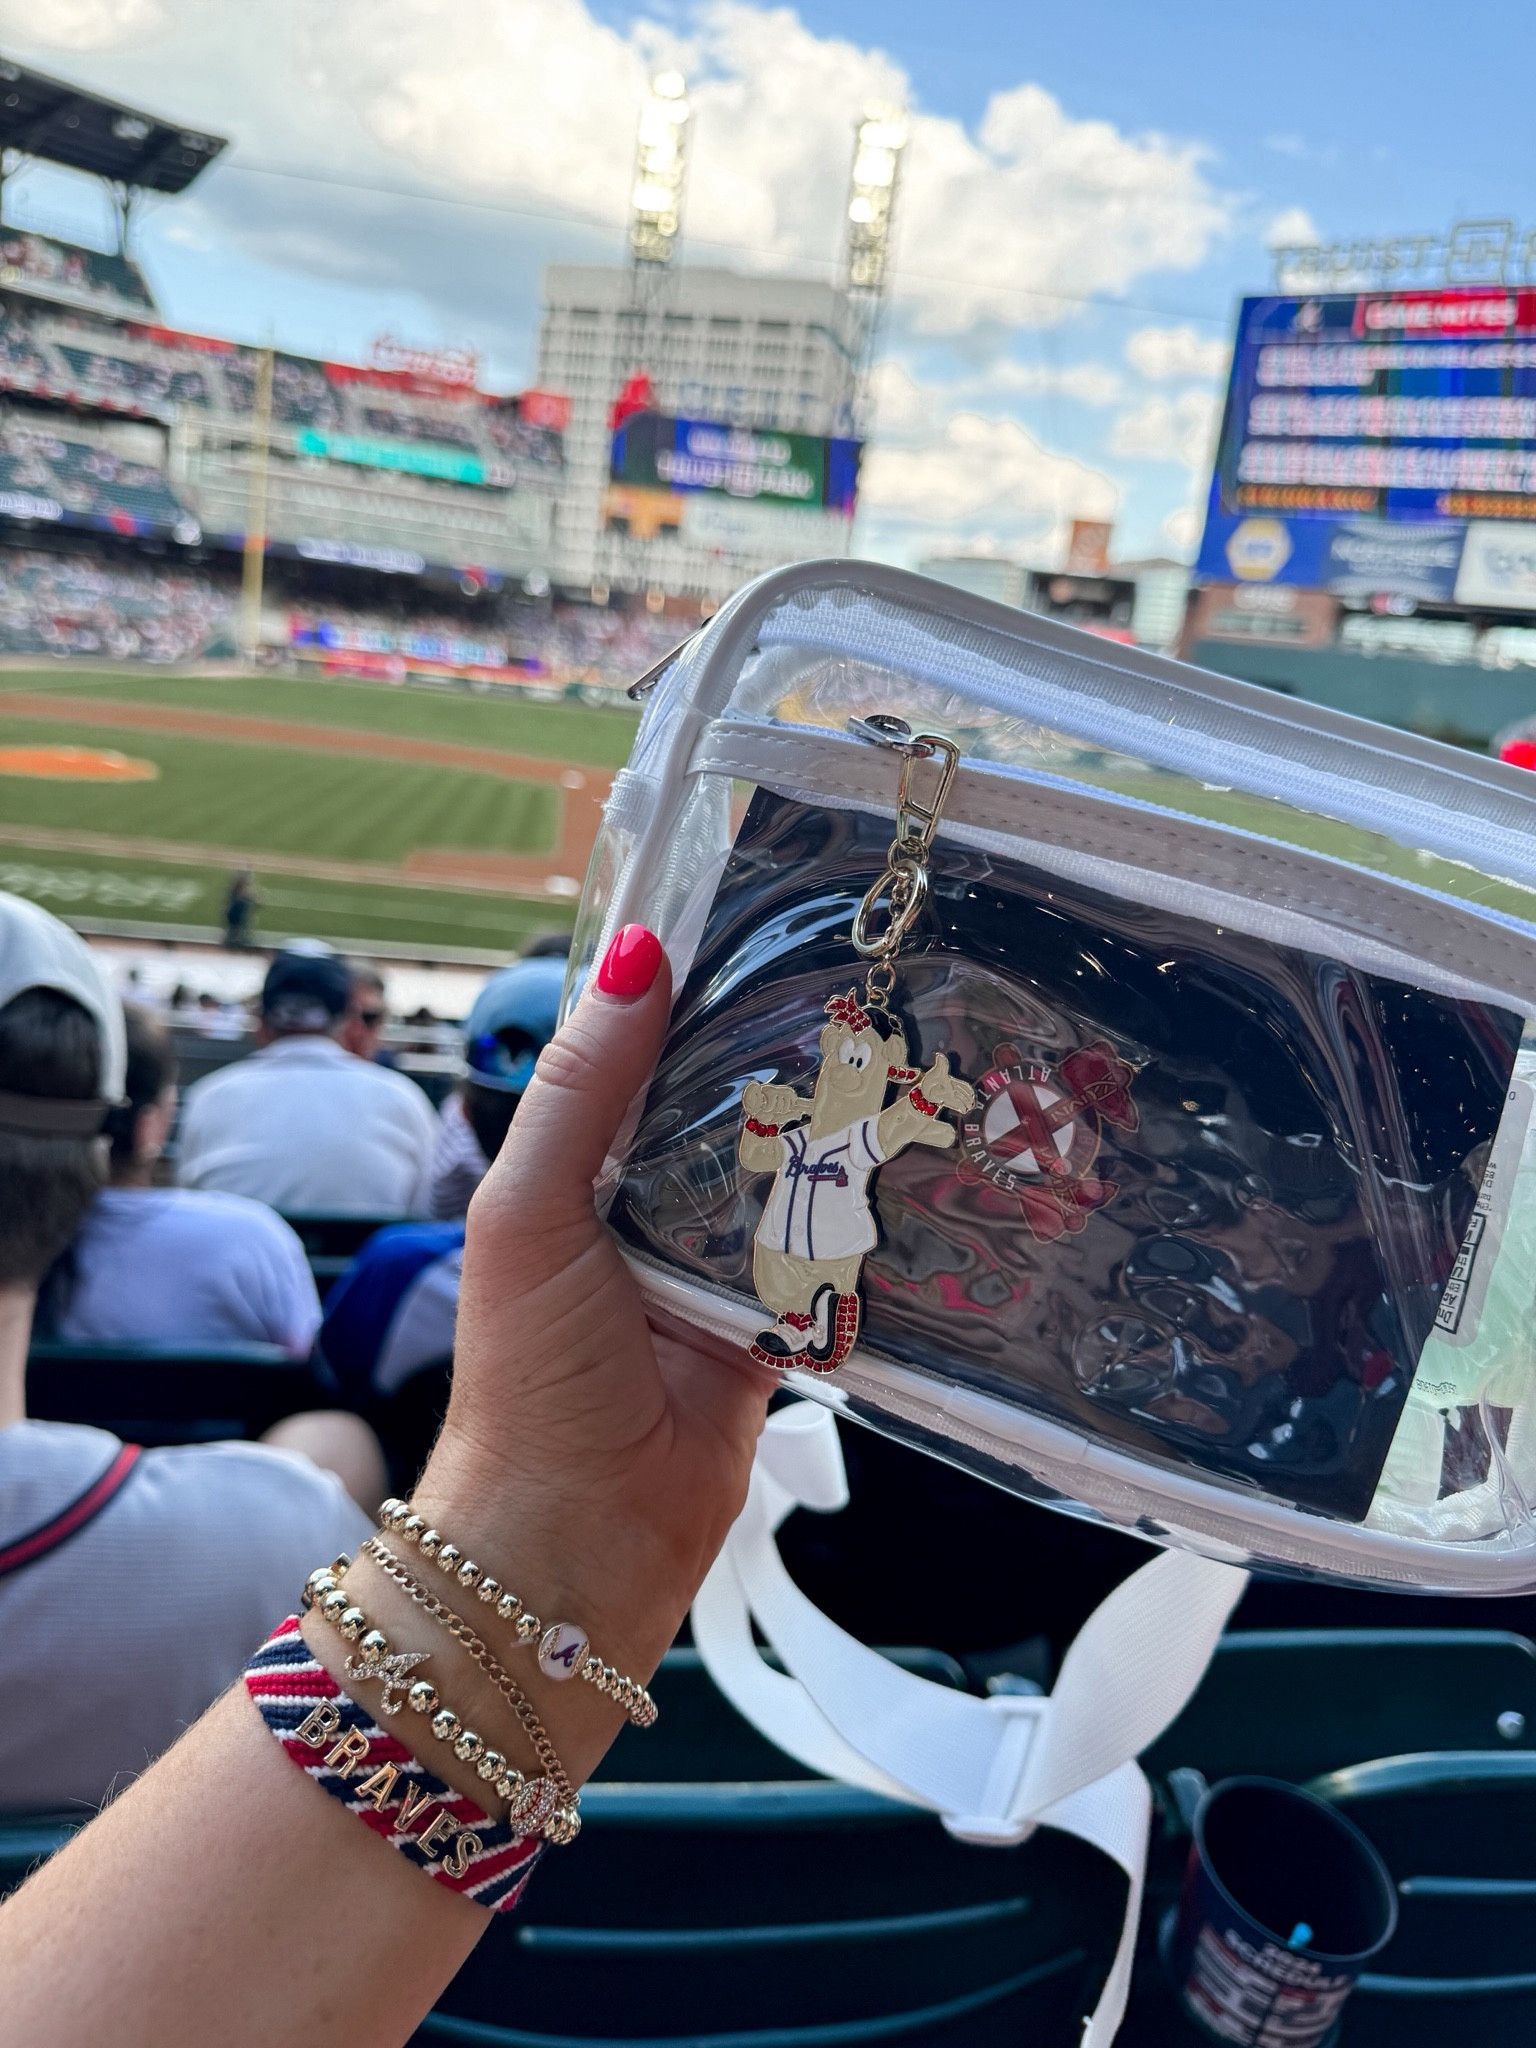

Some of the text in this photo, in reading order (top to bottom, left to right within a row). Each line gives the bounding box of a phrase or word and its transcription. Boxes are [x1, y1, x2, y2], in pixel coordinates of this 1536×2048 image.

[785, 1155, 840, 1179] Braves
[964, 1065, 1052, 1190] ATLANTA BRAVES
[296, 1696, 483, 1879] BRAVES
